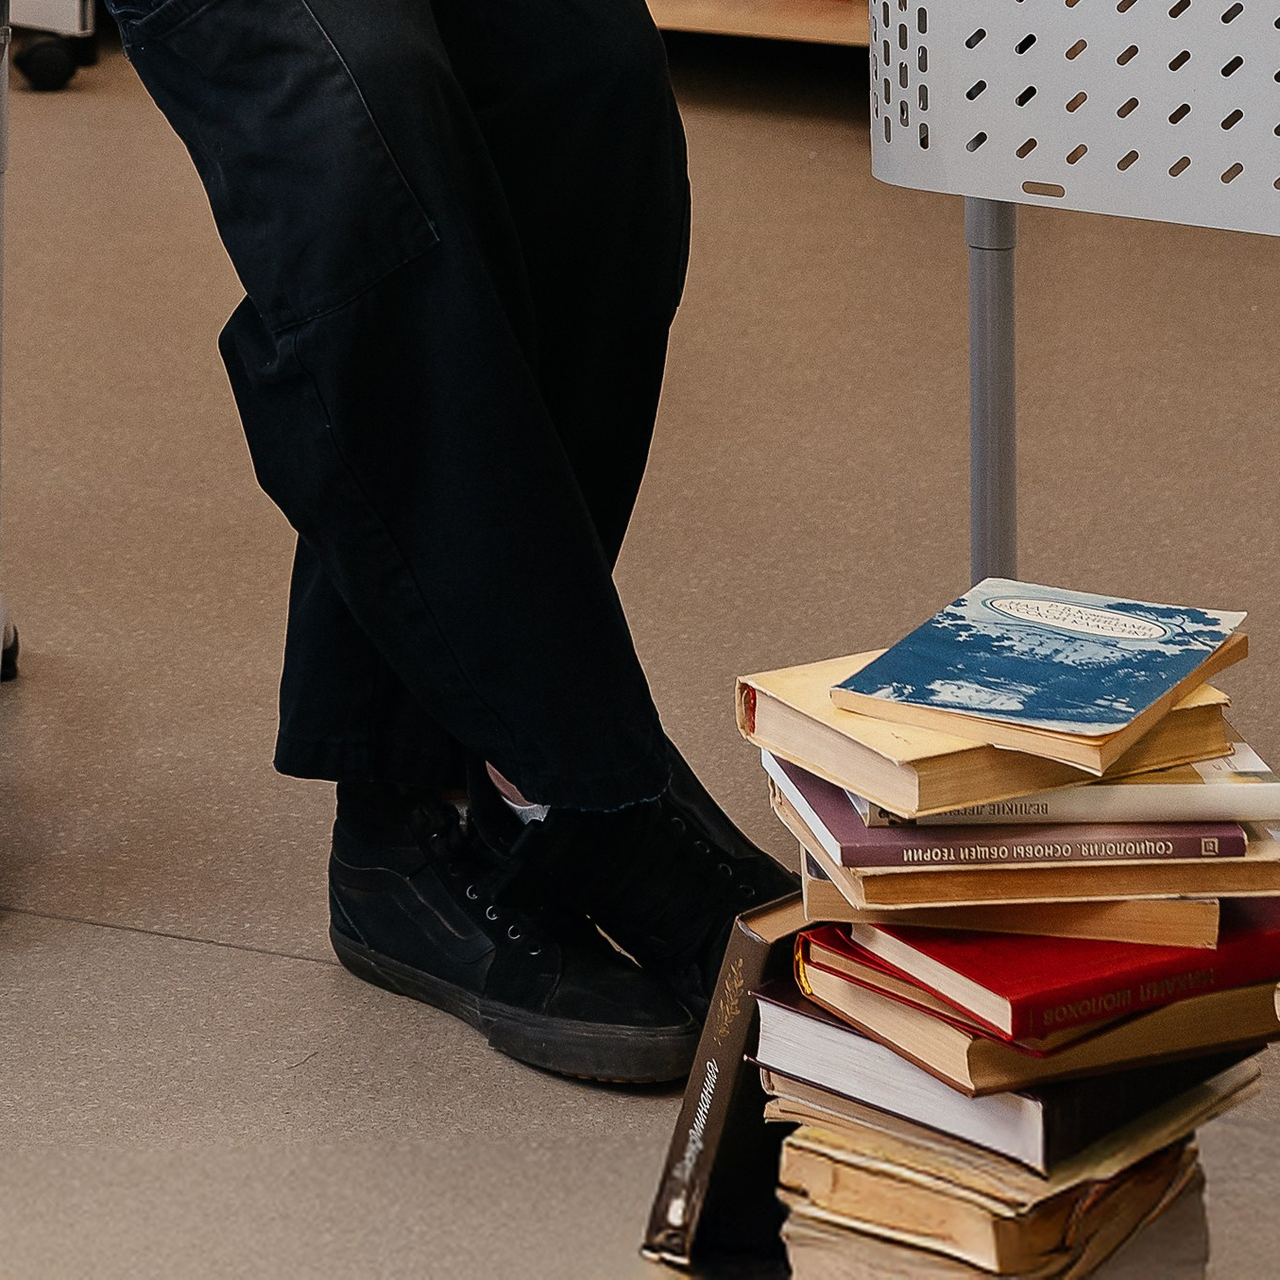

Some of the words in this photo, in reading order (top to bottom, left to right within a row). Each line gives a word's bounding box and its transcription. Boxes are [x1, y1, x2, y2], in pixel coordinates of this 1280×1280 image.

[987, 801, 1049, 817] ВЕЛИКИЕ
[902, 846, 956, 863] ТЕОРИИ
[959, 843, 1009, 862] ОБЩЕЙ
[1012, 843, 1072, 859] ОСНОВЫ
[1076, 840, 1174, 859] СОЦИОЛОГИЯ.
[1138, 966, 1215, 1003] МИХАИЛ
[1042, 987, 1132, 1027] ШОЛОХОВ
